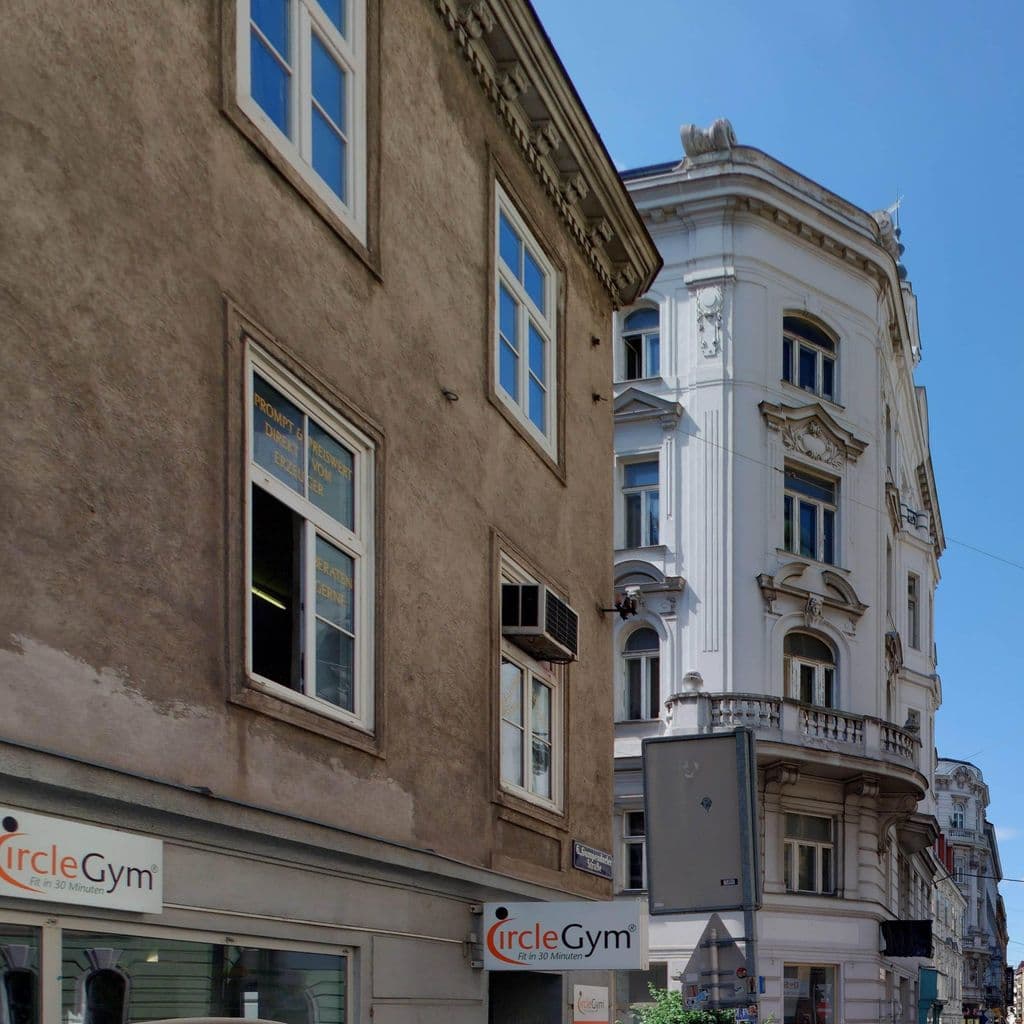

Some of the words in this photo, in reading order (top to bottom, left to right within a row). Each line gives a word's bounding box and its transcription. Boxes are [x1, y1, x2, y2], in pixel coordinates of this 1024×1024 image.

[254, 392, 294, 432] PROMPT
[265, 422, 298, 455] DIREKT
[312, 459, 332, 483] VOM
[30, 876, 41, 887] Fit
[43, 879, 51, 888] in
[54, 880, 66, 890] 30
[69, 882, 105, 895] Minuten
[518, 952, 527, 961] Fit
[529, 952, 536, 960] in
[538, 952, 549, 961] 30
[550, 952, 583, 961] Minuten
